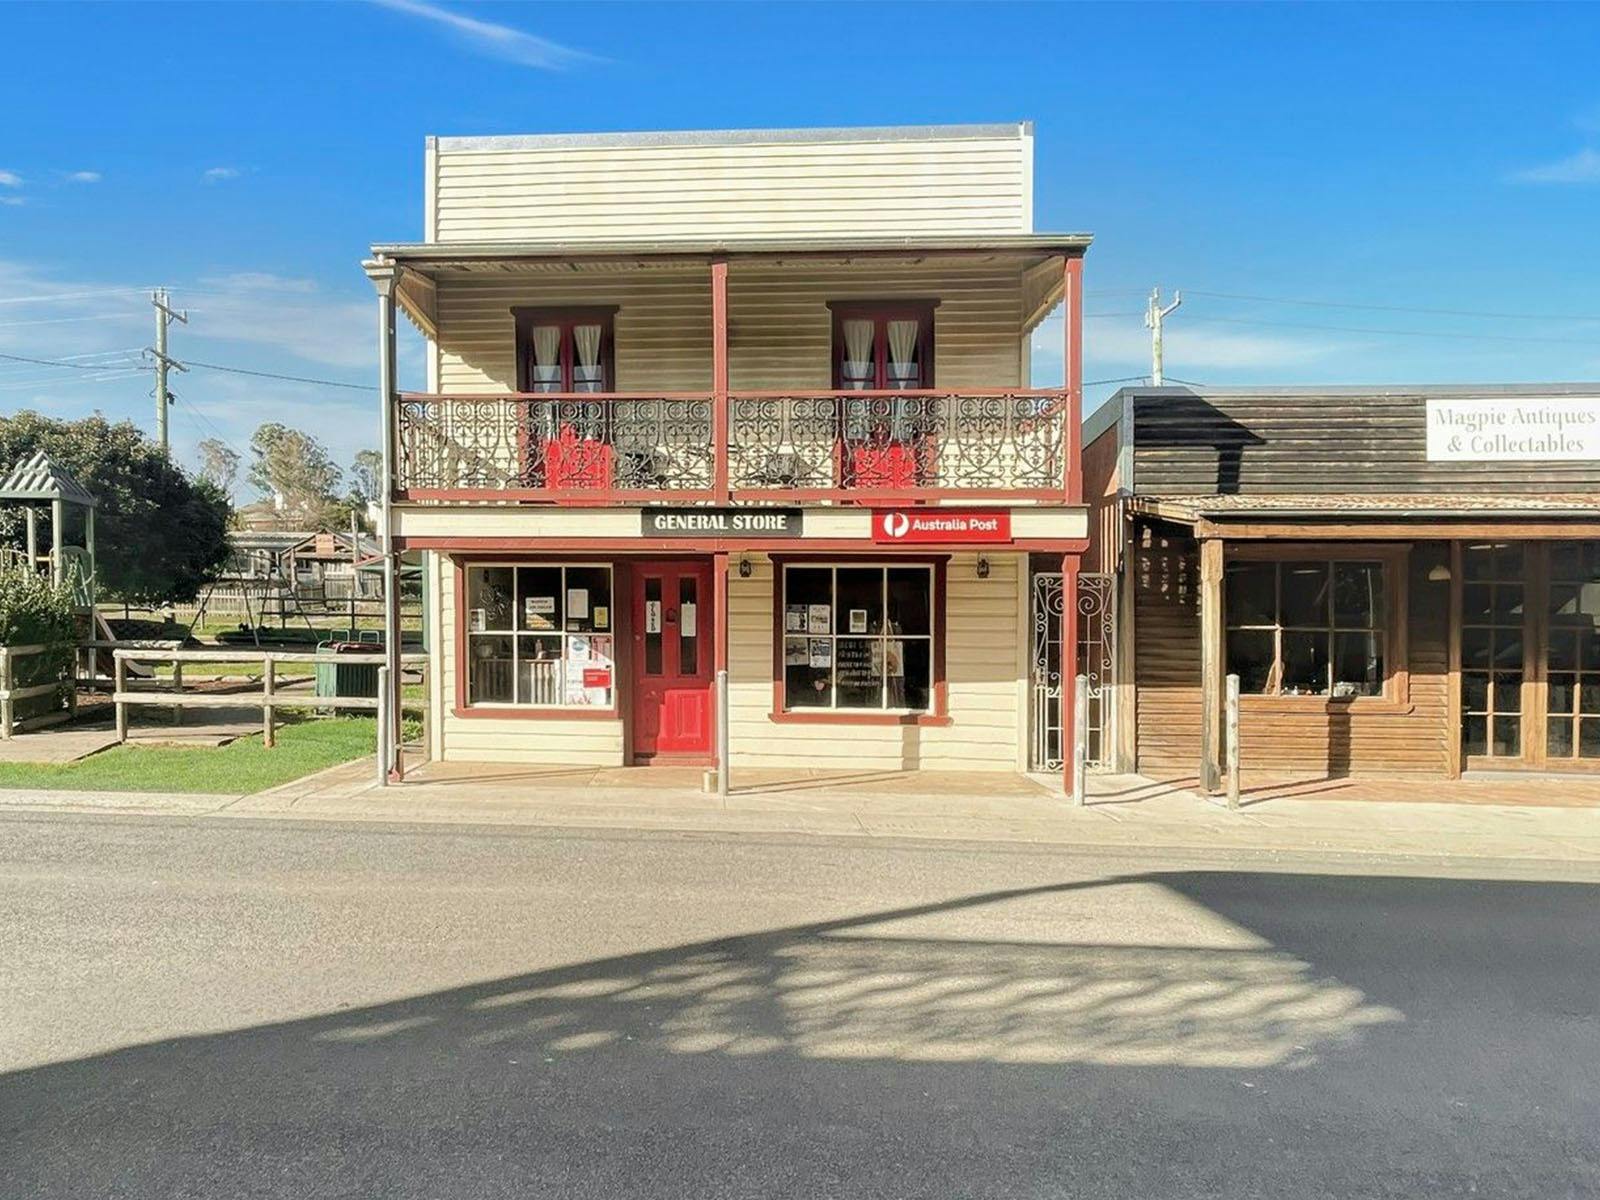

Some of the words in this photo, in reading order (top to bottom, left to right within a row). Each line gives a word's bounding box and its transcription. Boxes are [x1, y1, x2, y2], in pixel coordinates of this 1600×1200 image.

[1436, 408, 1506, 432] Magpie
[1512, 407, 1596, 431] Antiques
[1447, 435, 1462, 452] &
[1471, 434, 1584, 452] Collectables
[654, 514, 728, 529] GENERAL
[732, 514, 787, 529] STORE
[912, 518, 967, 530] Australia
[969, 519, 998, 530] Post
